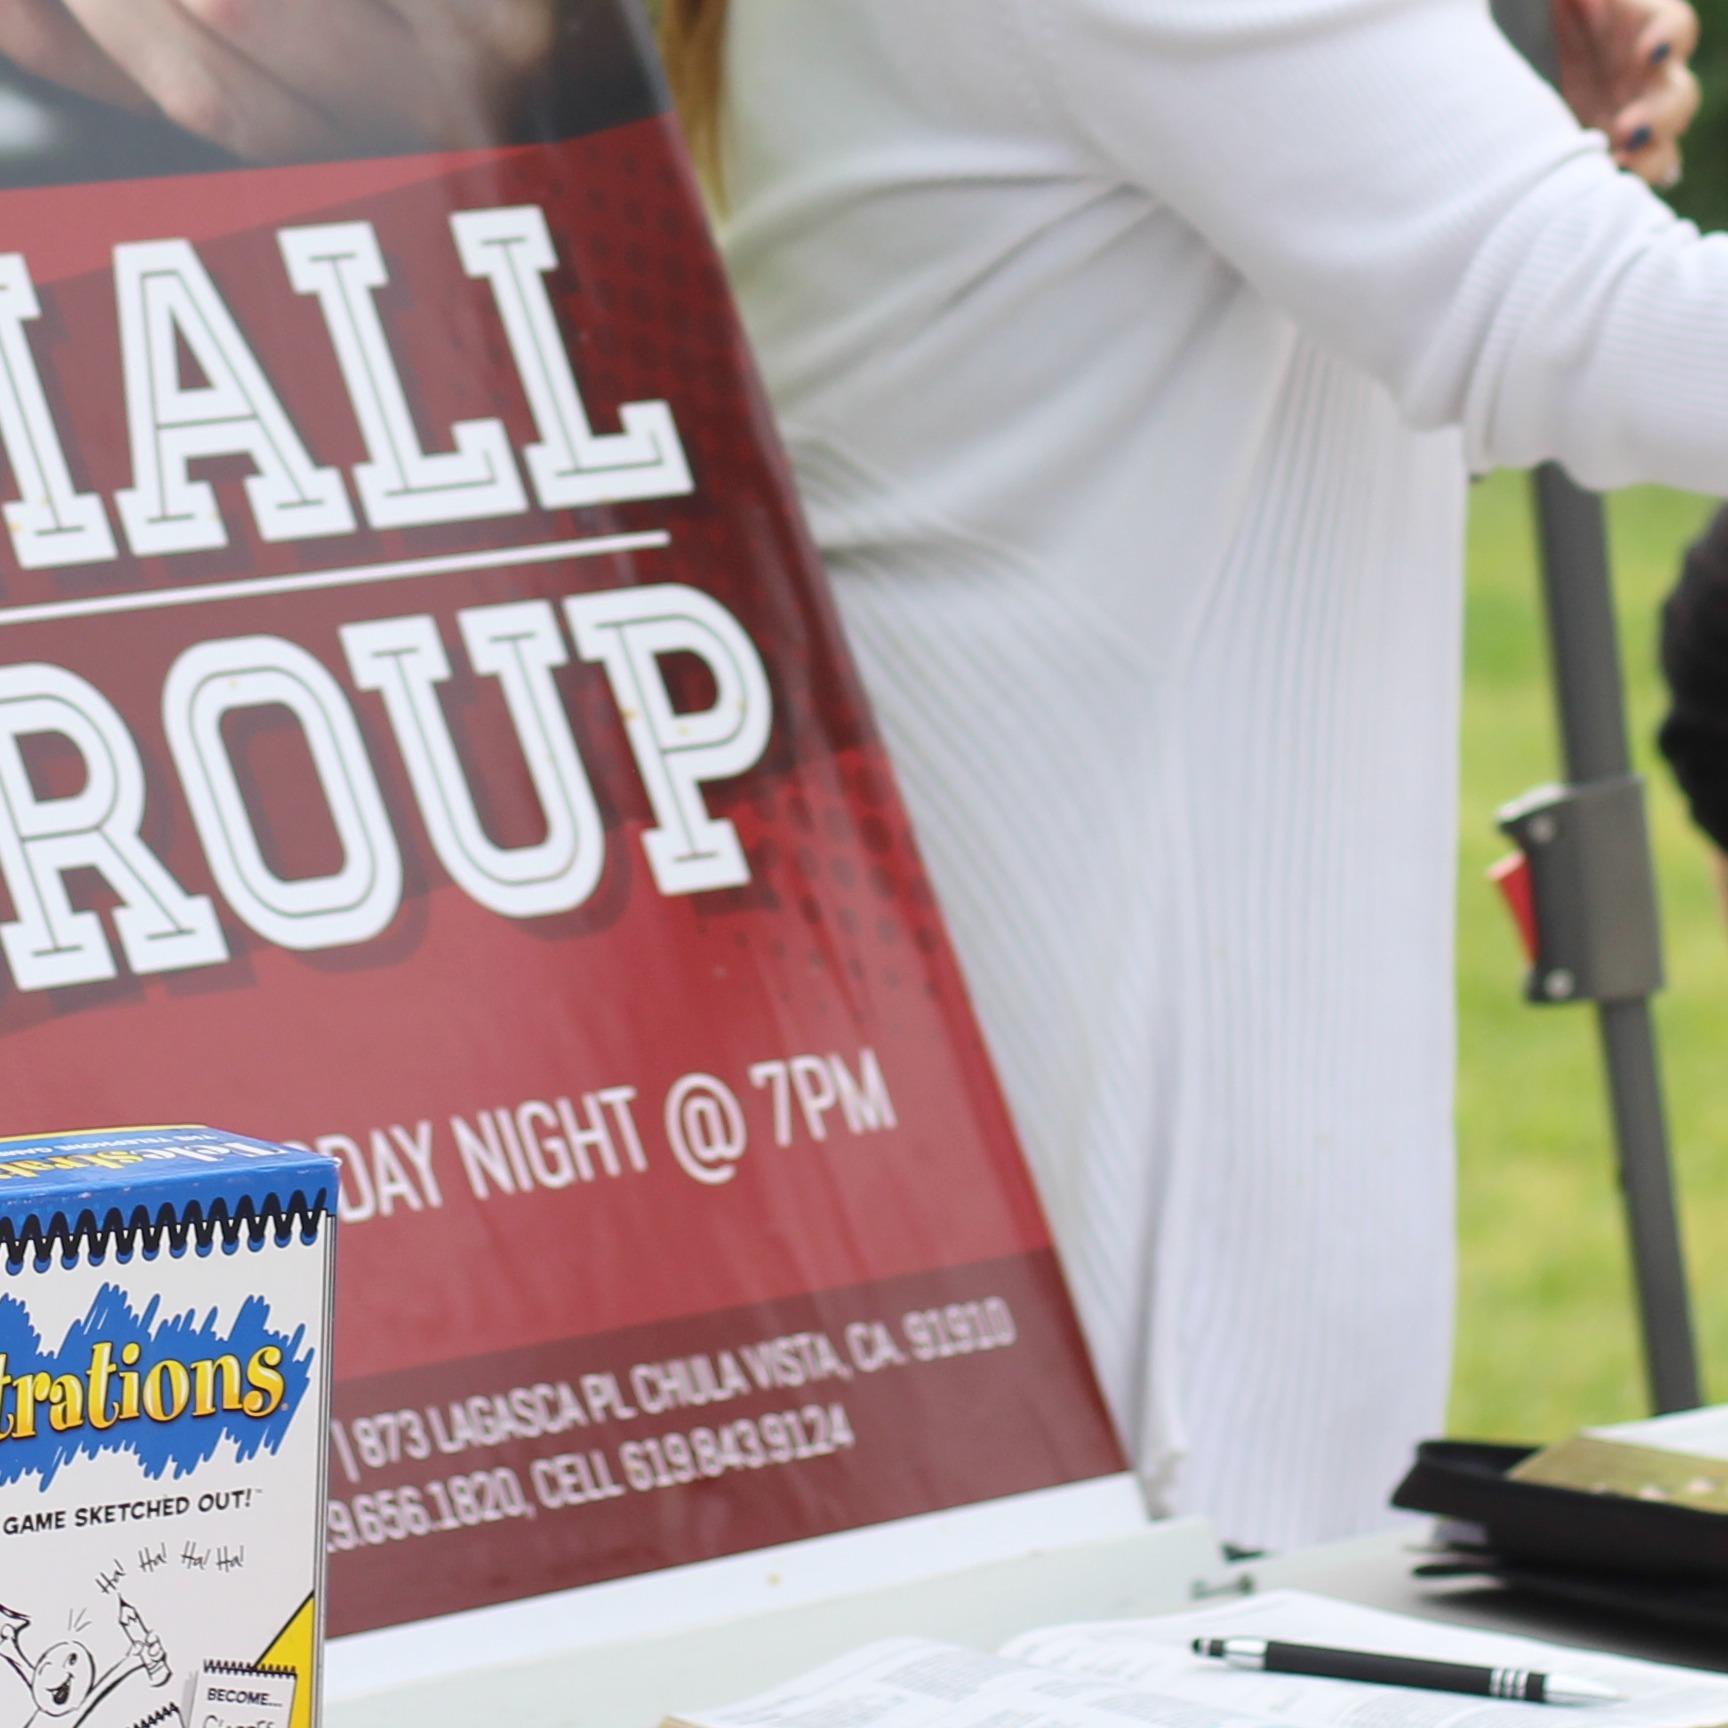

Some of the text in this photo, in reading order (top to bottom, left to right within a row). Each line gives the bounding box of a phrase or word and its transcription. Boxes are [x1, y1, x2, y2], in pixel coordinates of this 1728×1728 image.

[449, 1085, 648, 1201] NIGHT
[664, 1072, 747, 1185] @
[747, 1047, 898, 1148] 7PM
[352, 1409, 432, 1469] 873
[426, 1381, 590, 1455] LAGASCA
[580, 1373, 638, 1423] PL
[630, 1350, 751, 1414] CHULA
[739, 1332, 854, 1388] VISTA,
[902, 1295, 1017, 1362] 91910
[530, 1448, 626, 1510] CELL
[3, 1510, 67, 1535] GAME
[74, 1496, 190, 1528] SKETCHED
[138, 1542, 167, 1573] Ha!
[180, 1540, 212, 1570] Ha!
[216, 1544, 245, 1573] Ha!
